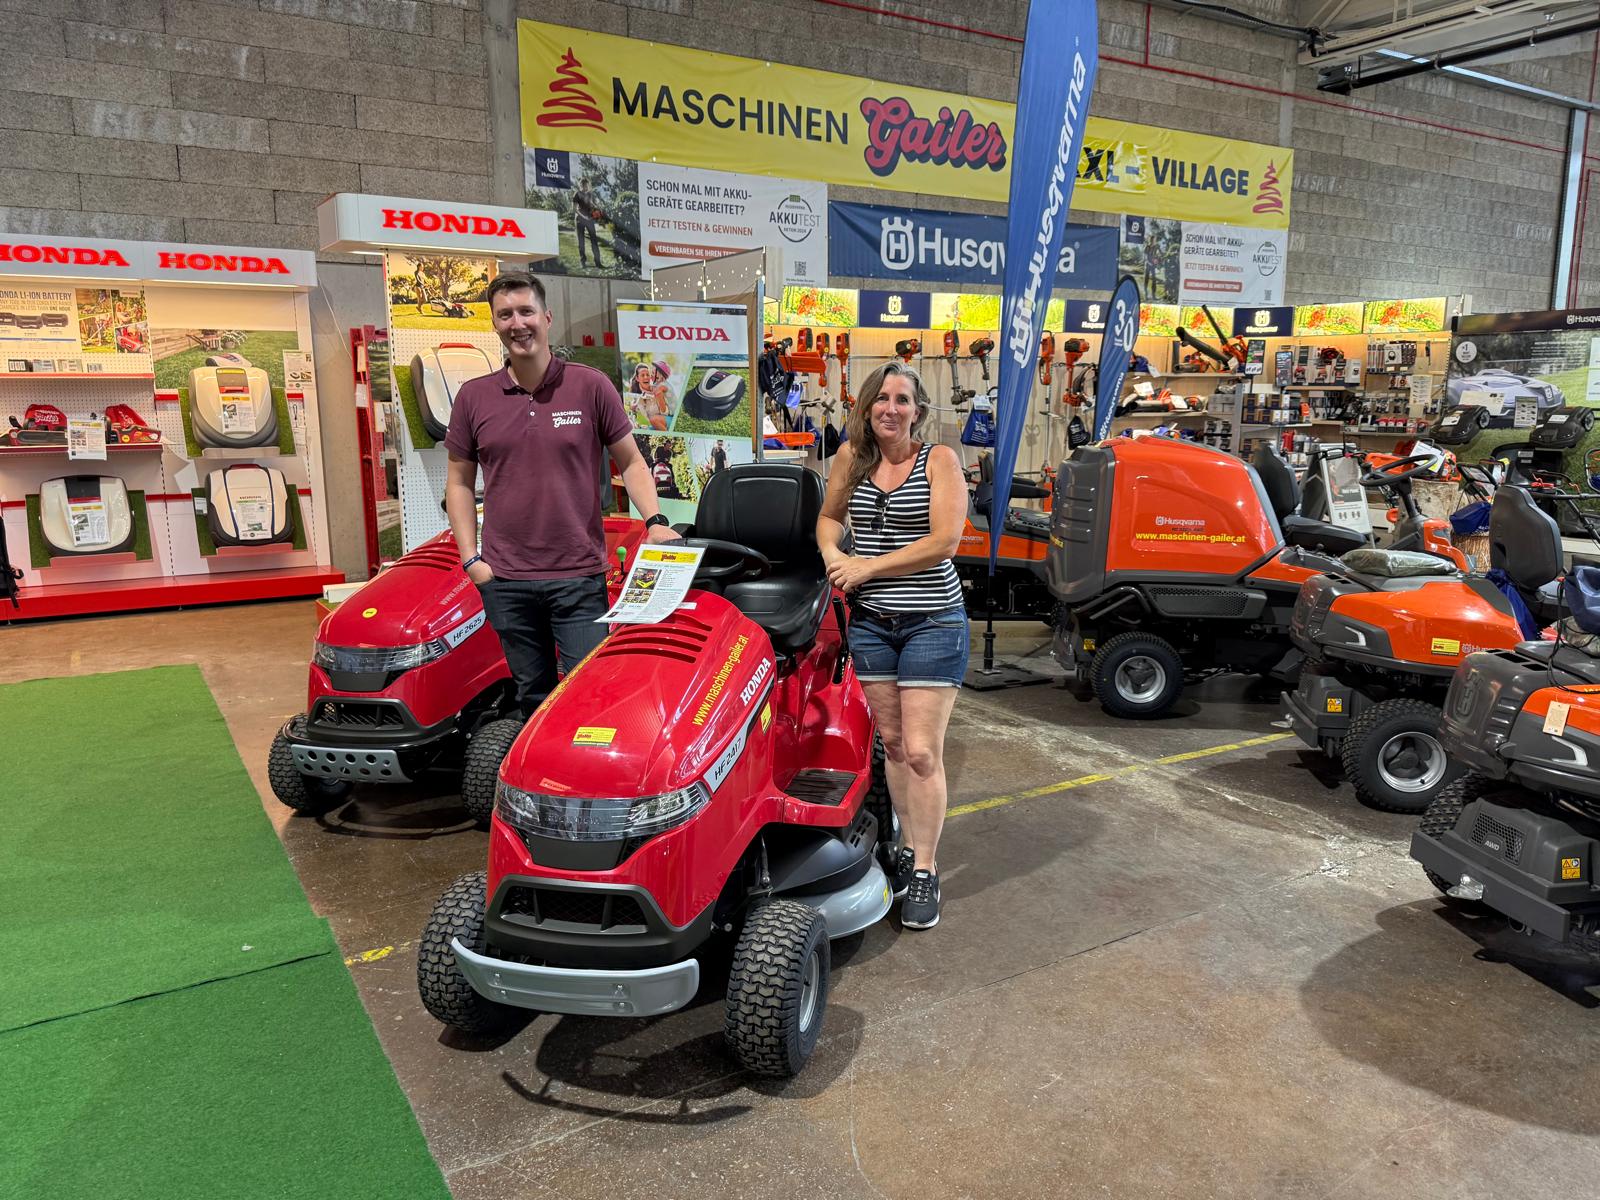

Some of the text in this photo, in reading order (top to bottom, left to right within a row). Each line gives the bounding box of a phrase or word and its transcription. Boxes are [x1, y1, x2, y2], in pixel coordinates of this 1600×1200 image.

[612, 77, 1007, 177] MASCHINEN Gailer
[1152, 156, 1249, 196] VILLAGE
[646, 179, 752, 200] SCHON MAL MIT AKKU-
[647, 195, 745, 216] GERÄTE GEARBEITET?
[382, 209, 526, 238] HONDA
[648, 218, 670, 228] JETZT
[672, 220, 702, 232] TESTEN
[712, 225, 753, 236] GEWINNEN
[769, 211, 821, 228] AKKUTEST
[159, 252, 290, 274] HONDA
[0, 291, 18, 299] ONDA
[43, 292, 72, 300] BATTERY
[638, 325, 730, 342] HONDA
[553, 416, 582, 428] Gailer
[1164, 518, 1205, 526] Husqvarna
[1136, 532, 1245, 543] www.maschinen-gailer.at
[453, 617, 482, 642] HF 2625
[692, 634, 749, 727] www.maschinen-gailer.at
[739, 657, 771, 706] HONDA
[1485, 840, 1500, 851] AWD
